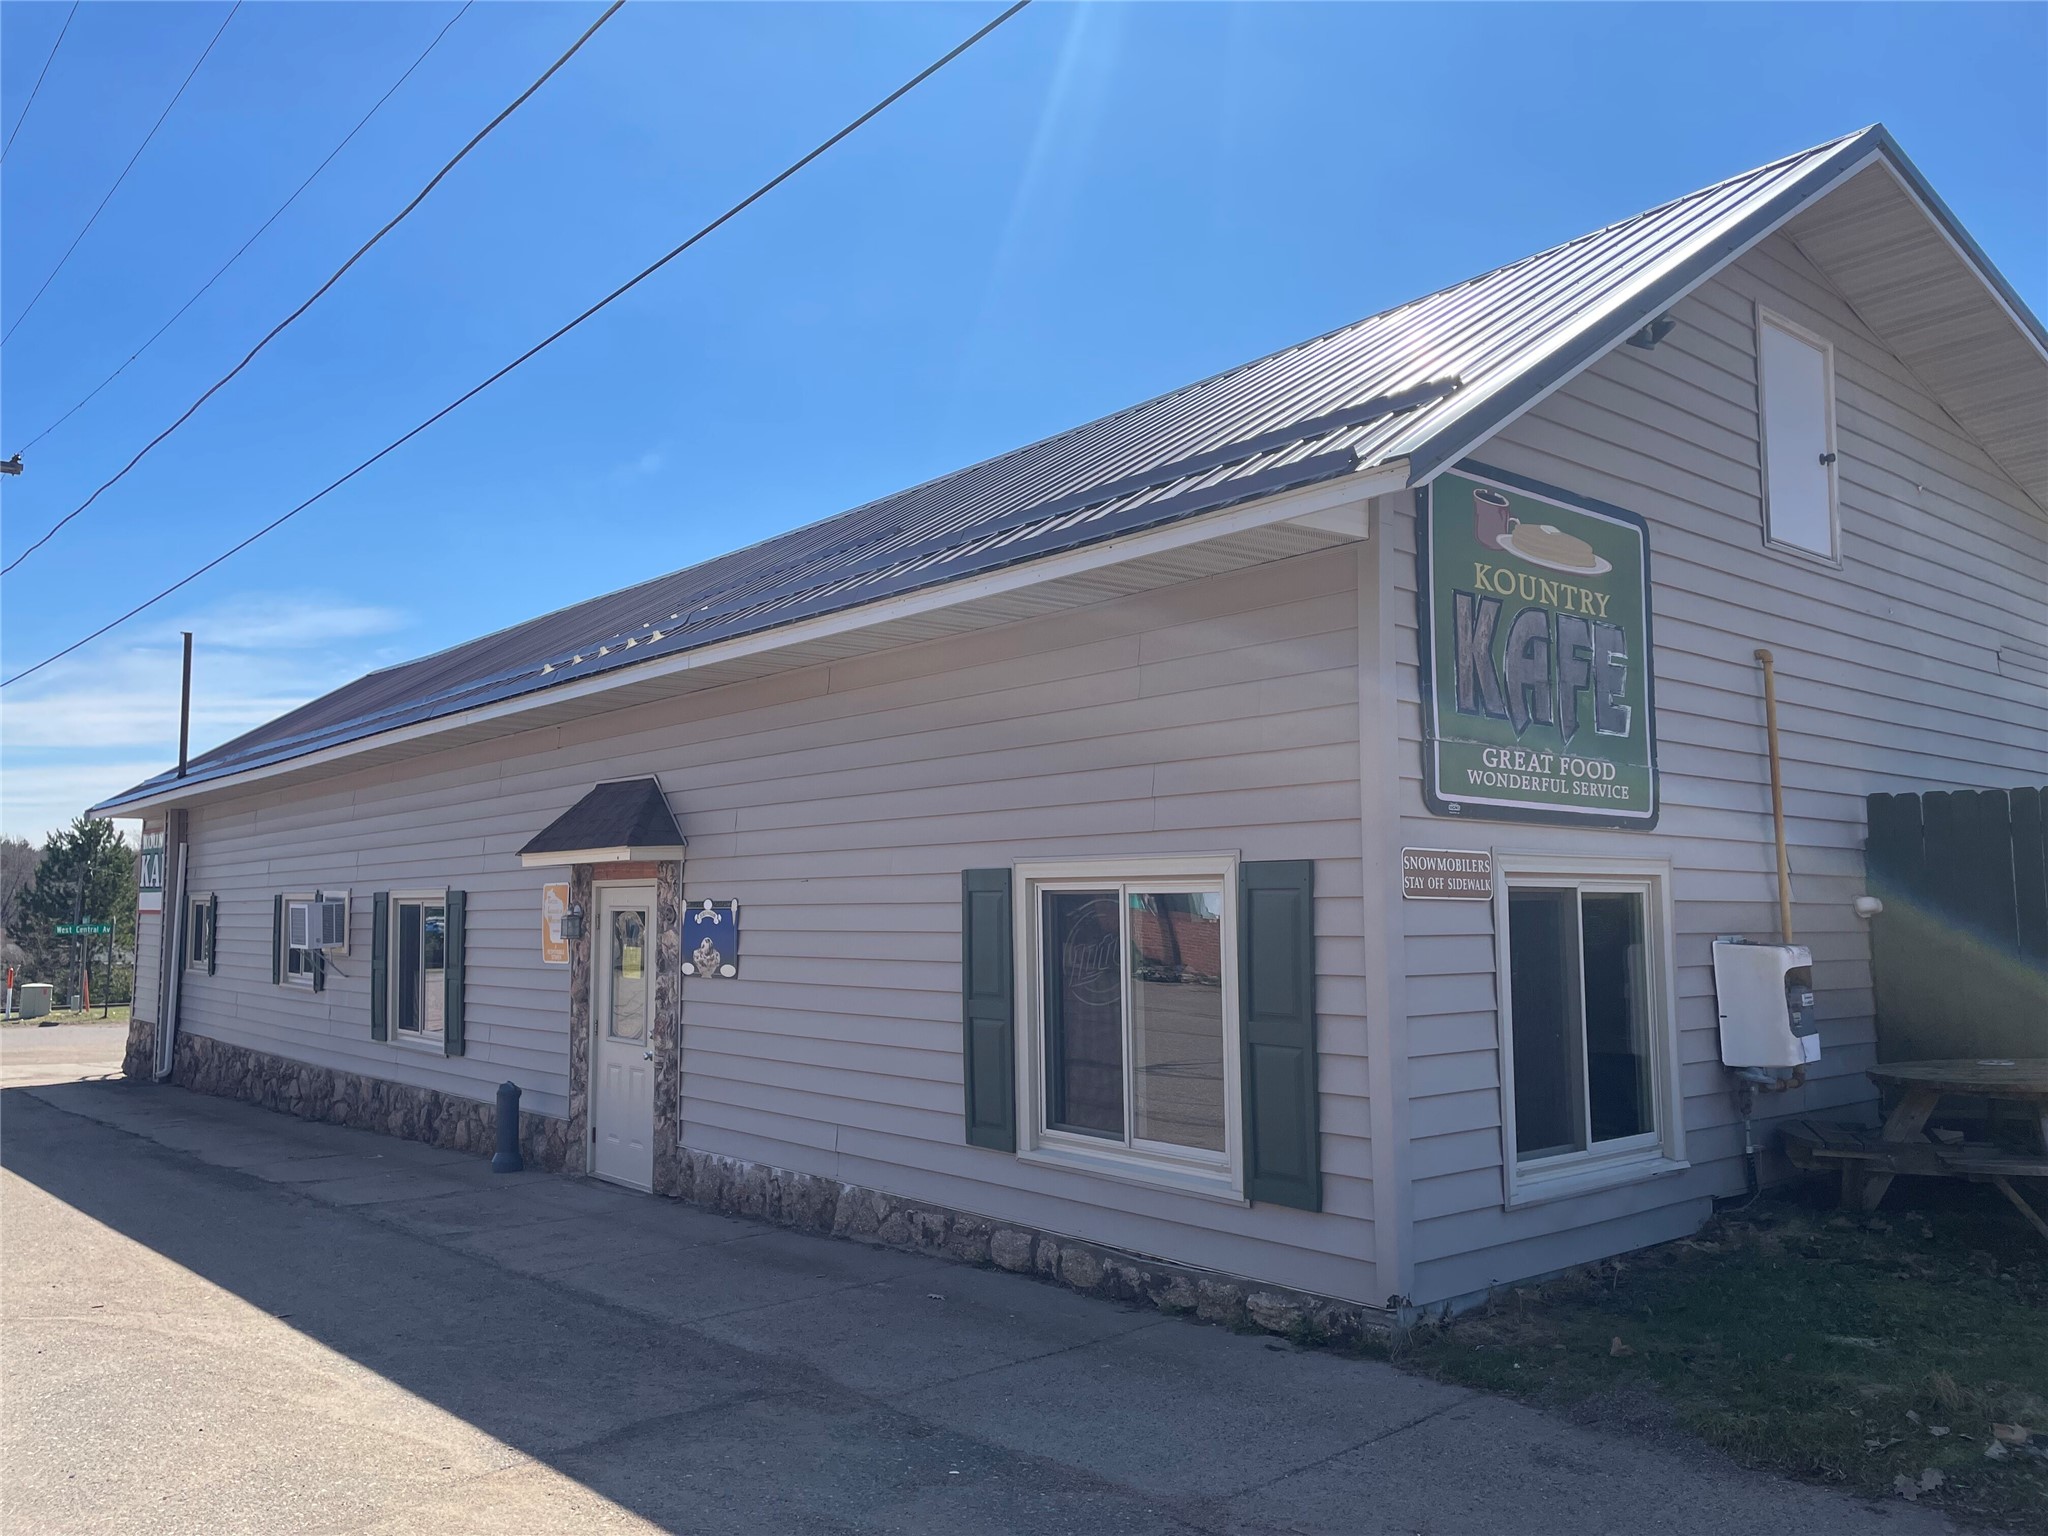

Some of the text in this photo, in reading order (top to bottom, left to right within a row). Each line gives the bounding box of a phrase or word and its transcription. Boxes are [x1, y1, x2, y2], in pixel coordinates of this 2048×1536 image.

[1474, 563, 1611, 618] KOUNTRY
[1452, 588, 1632, 747] KAFE
[1482, 748, 1616, 781] GREAT FOOD
[1467, 769, 1629, 800] WONDERFUL SERVICE
[1403, 856, 1491, 873] SNOWMOBILERS
[1404, 876, 1491, 891] STAY OFF SIDEWALK
[56, 926, 72, 934] West
[75, 925, 99, 934] Central
